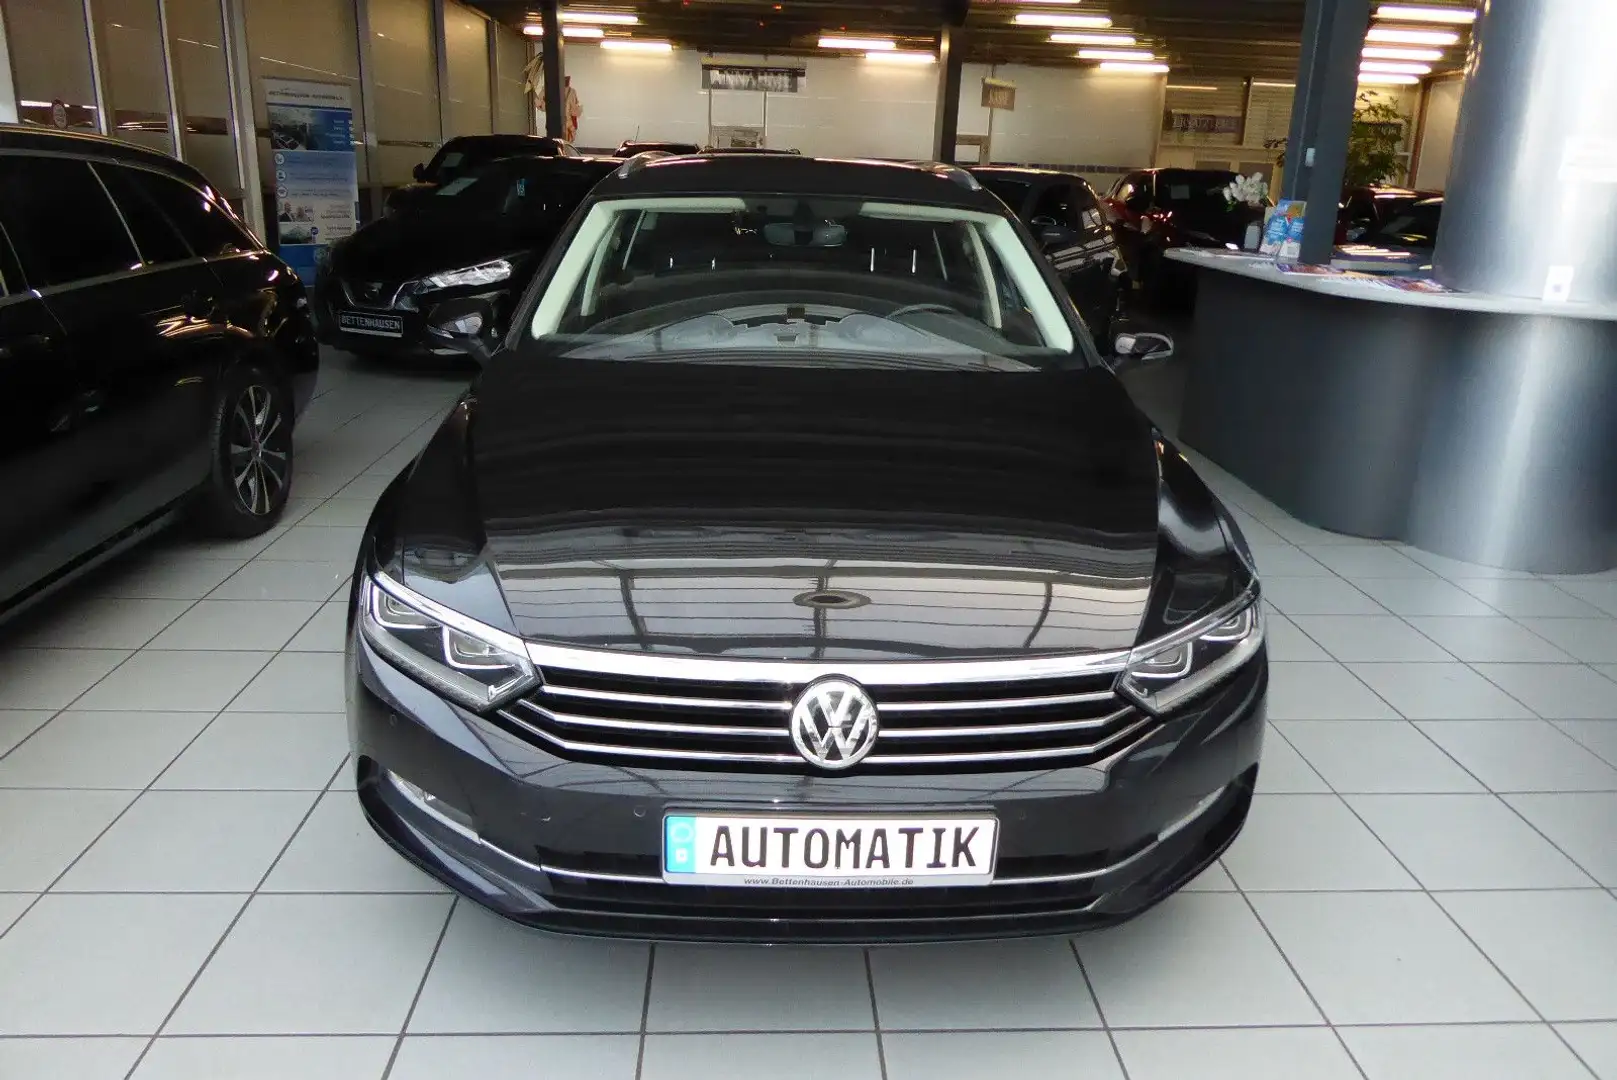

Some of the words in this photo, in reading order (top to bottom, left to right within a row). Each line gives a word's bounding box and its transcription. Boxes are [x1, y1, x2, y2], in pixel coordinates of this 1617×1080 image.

[341, 315, 401, 329] BETTENHAUSEN
[794, 682, 876, 767] VW
[710, 825, 980, 870] AUTOMATIK
[743, 877, 914, 887] www.Bettenhausen-Automobile.de
